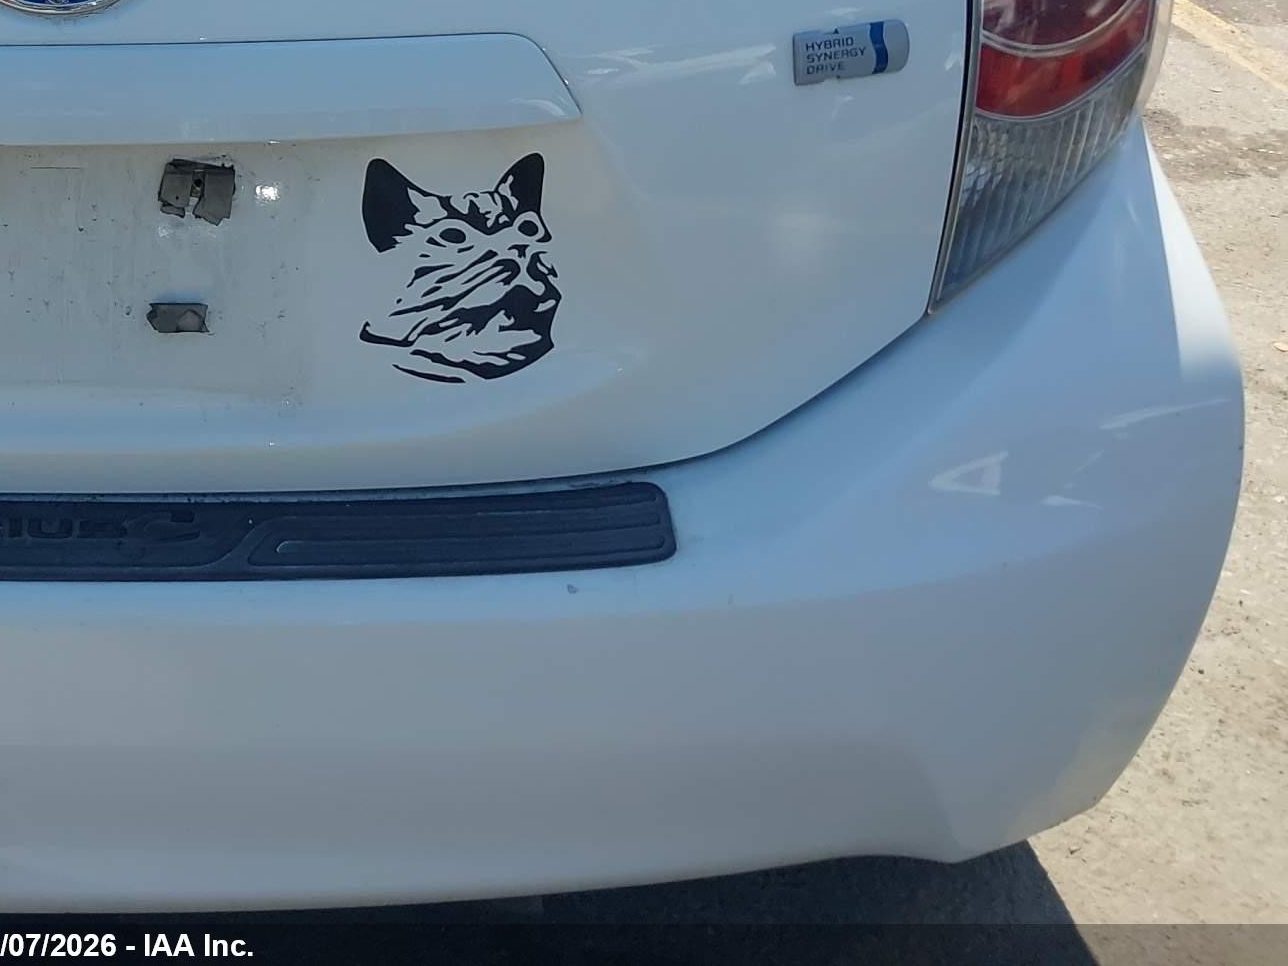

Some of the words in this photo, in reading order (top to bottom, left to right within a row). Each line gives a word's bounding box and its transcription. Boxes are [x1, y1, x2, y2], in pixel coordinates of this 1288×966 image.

[805, 36, 854, 52] HYBRID
[806, 46, 866, 64] SYNERGY
[806, 61, 847, 74] DRIVE
